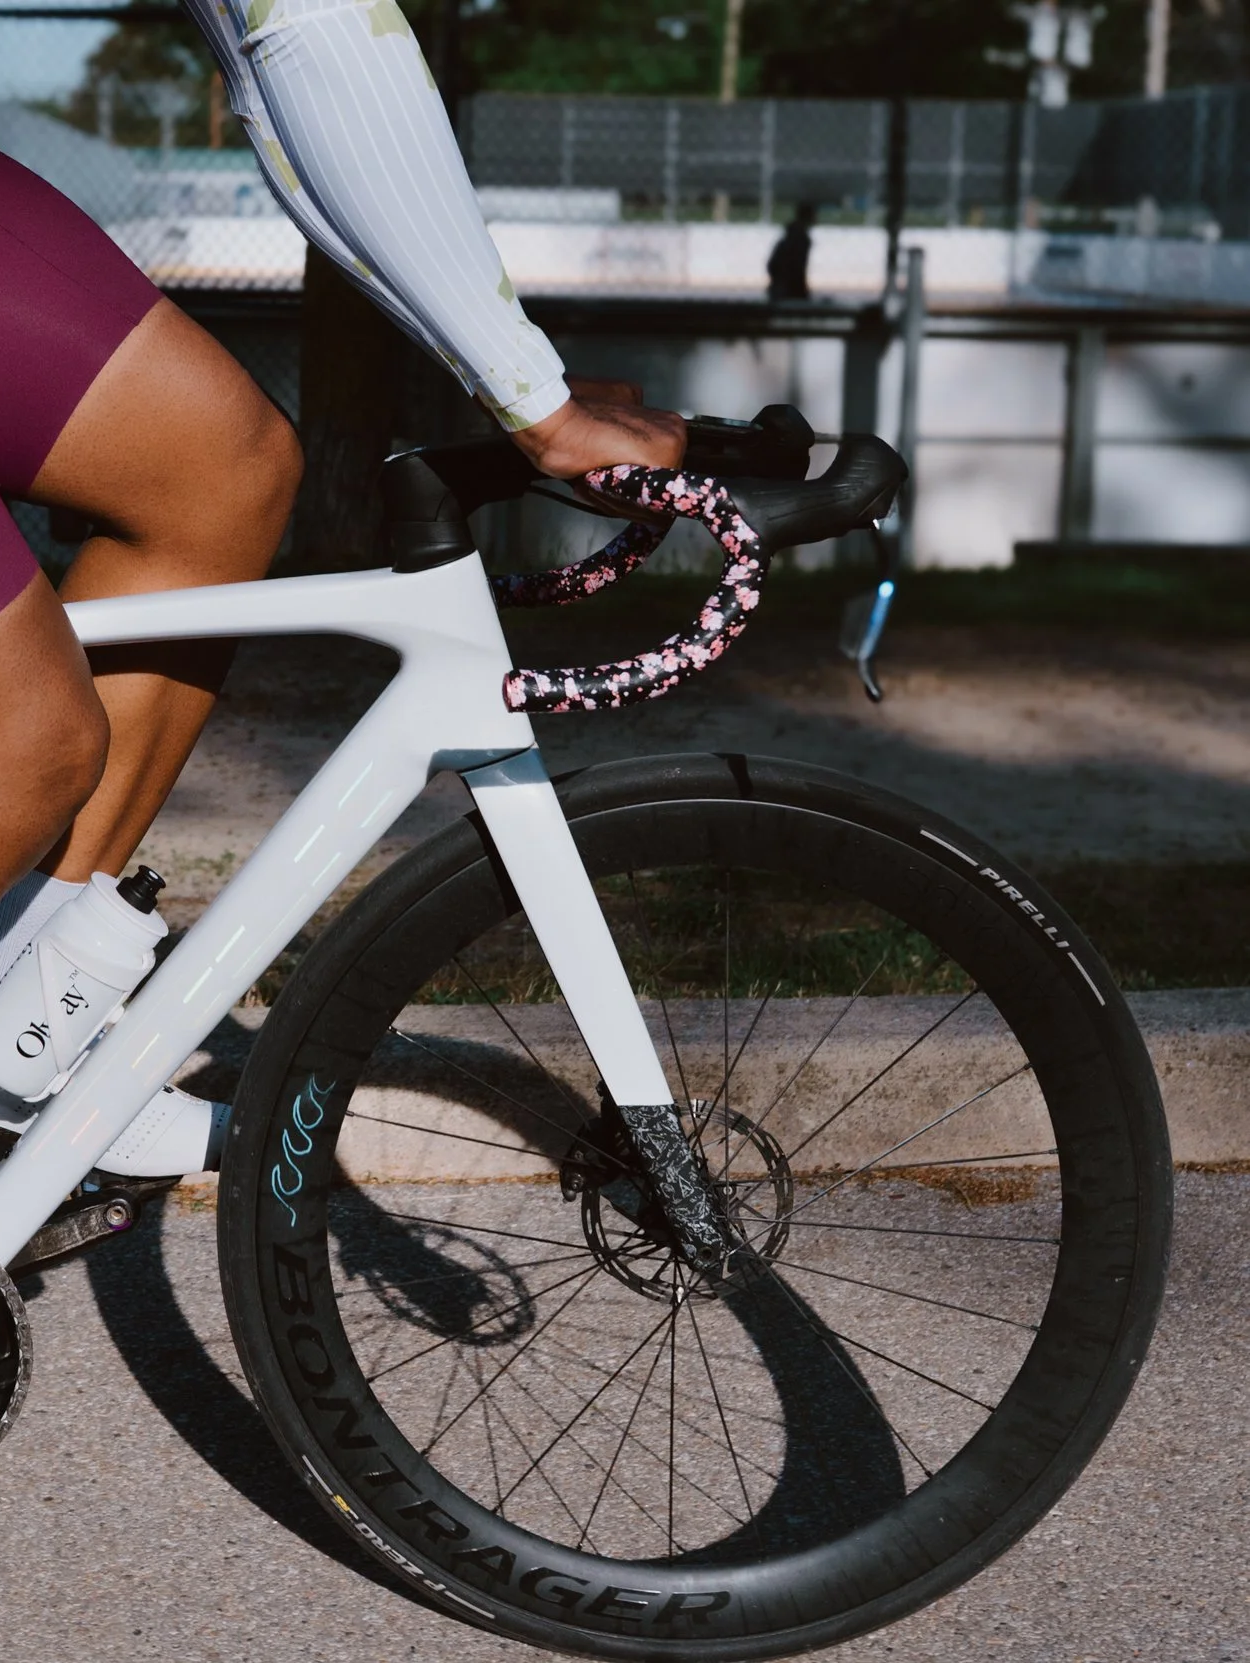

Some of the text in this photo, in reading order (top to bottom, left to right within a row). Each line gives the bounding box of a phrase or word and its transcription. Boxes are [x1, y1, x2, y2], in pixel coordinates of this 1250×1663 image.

[979, 867, 1070, 948] PIRELLI
[272, 1242, 731, 1625] BONTRAGER
[355, 1522, 446, 1591] P ZERO
